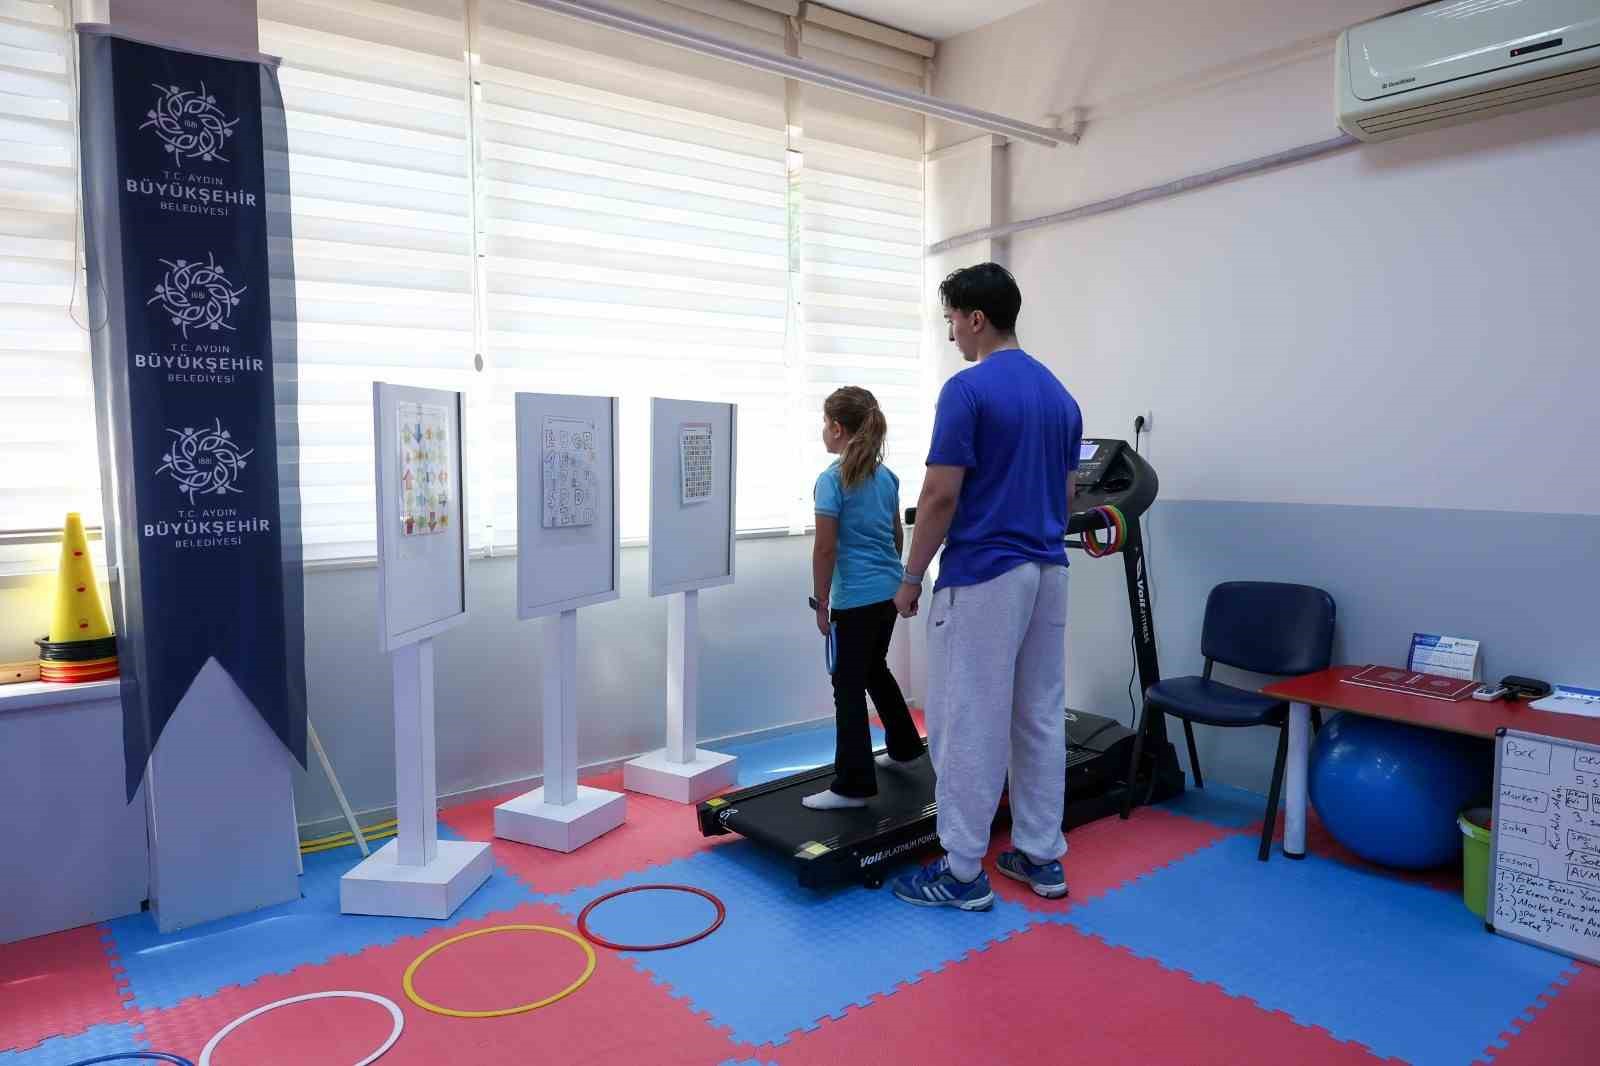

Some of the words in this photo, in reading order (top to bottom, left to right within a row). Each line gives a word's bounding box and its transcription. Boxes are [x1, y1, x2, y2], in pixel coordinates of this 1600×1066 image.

[188, 173, 224, 186] AYDIN
[126, 177, 257, 207] BÜYÜKŞEHİR
[160, 201, 229, 217] BELEDİYESİ
[195, 344, 231, 353] AYDIN
[135, 352, 264, 373] BÜYÜKŞEHİR
[168, 374, 235, 384] BELEDİYESİ
[202, 508, 237, 518] AYDIN
[144, 517, 271, 537] BÜYÜKŞEHİR
[175, 536, 241, 549] BELEDİYESİ
